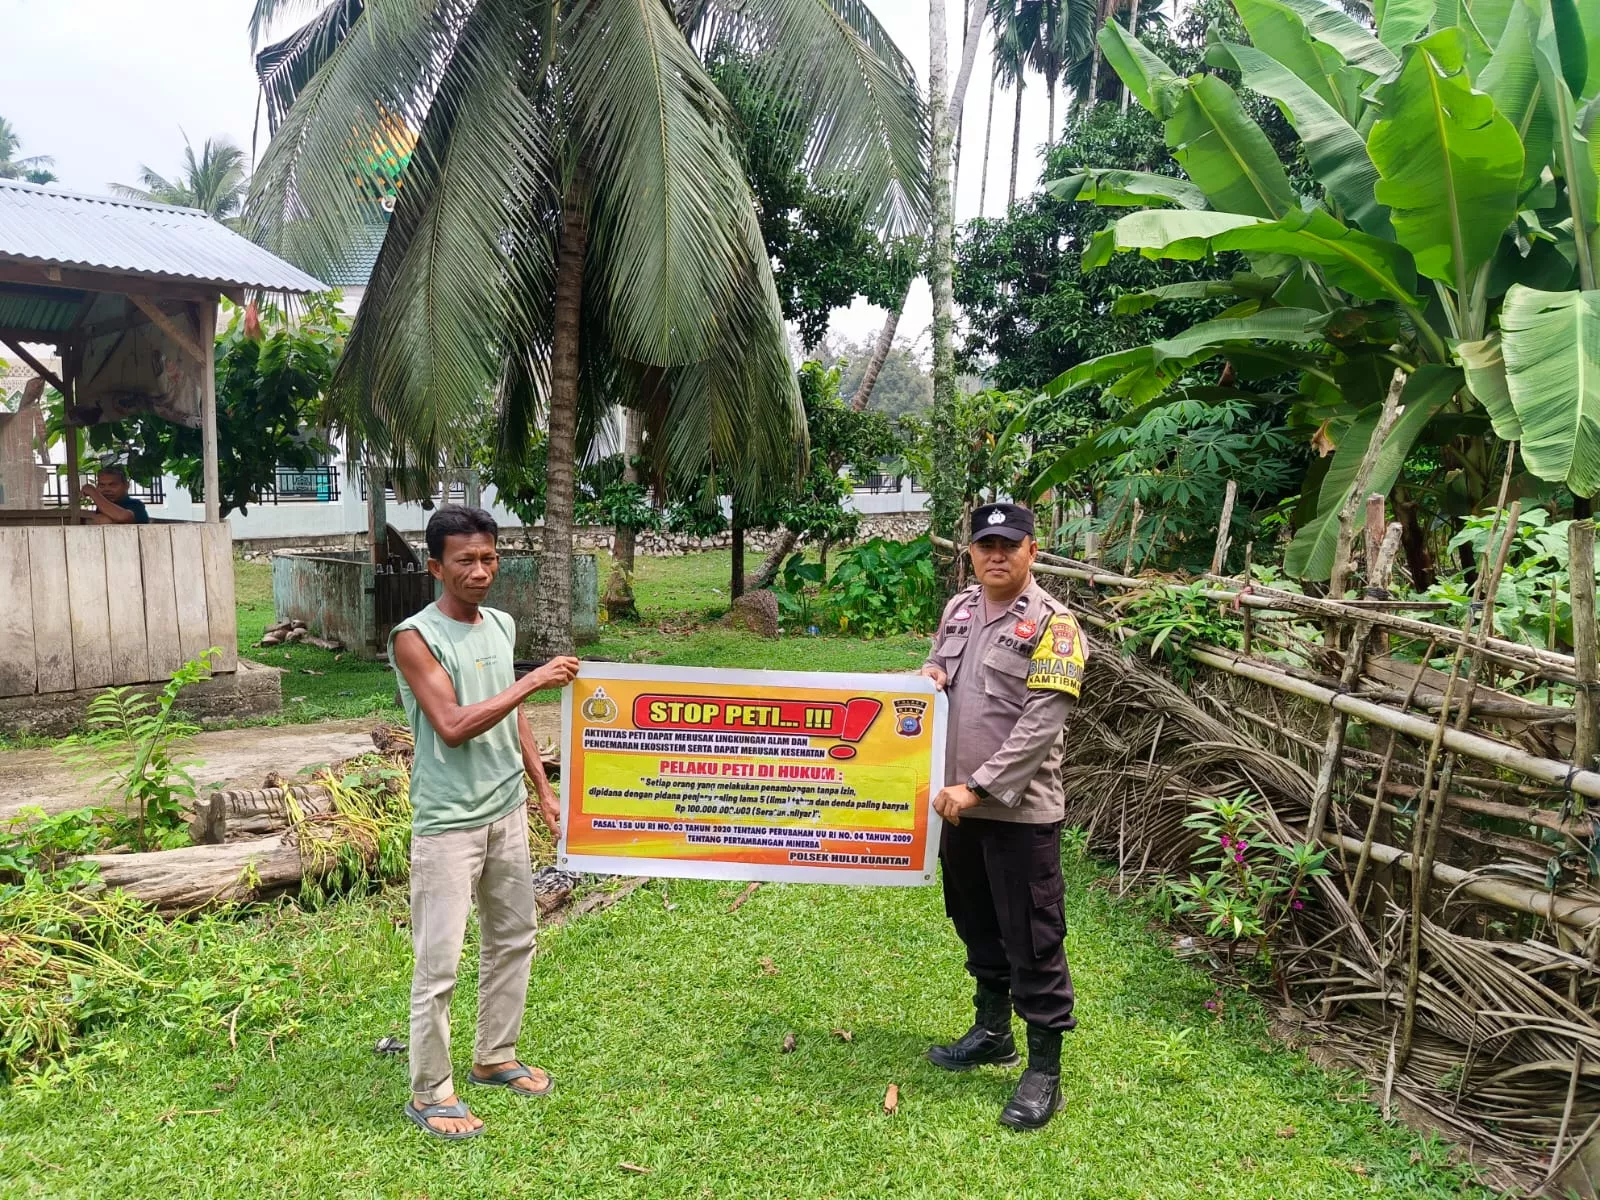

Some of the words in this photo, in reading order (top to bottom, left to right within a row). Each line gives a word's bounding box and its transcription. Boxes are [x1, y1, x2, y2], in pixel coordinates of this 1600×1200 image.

[650, 701, 719, 724] STOP
[725, 704, 799, 727] PETI...
[804, 708, 832, 729] !!!
[584, 729, 627, 739] AKTIVITAS
[628, 730, 646, 740] PETI
[648, 731, 673, 741] DAPAT
[674, 733, 714, 742] MERUSAK
[715, 734, 766, 744] LINGKUNGAN
[768, 737, 790, 745] ALAM
[791, 738, 808, 746] DAN
[584, 740, 639, 750] PENCEMARAN
[640, 742, 686, 752] EKOSISTEM
[688, 744, 712, 753] SERTA
[714, 745, 739, 754] DAPAT
[740, 746, 779, 756] MERUSAK
[781, 748, 825, 758] KESEHATAN
[660, 760, 718, 776] PELAKU
[721, 764, 754, 777] PETI
[758, 765, 774, 778] DI
[778, 766, 835, 780] HUKUM
[646, 778, 671, 789] Setiap
[673, 780, 695, 790] orang
[697, 782, 716, 791] yang
[717, 782, 759, 791] melakukan
[817, 786, 839, 796] tanpa
[588, 787, 622, 797] dipidana
[624, 790, 653, 800] dengan
[654, 792, 681, 801] pidana
[739, 795, 758, 803] lama
[815, 799, 829, 807] dan
[831, 800, 855, 808] denda
[856, 800, 881, 810] paling
[882, 802, 909, 812] banyak
[675, 804, 686, 814] Rp
[593, 820, 616, 828] PASAL
[618, 821, 632, 829] 158
[634, 821, 646, 829] UU
[648, 822, 655, 830] RI
[657, 822, 672, 830] NO.
[673, 823, 683, 831] 03
[685, 824, 710, 832] TAHUN
[712, 825, 731, 833] 2020
[733, 826, 767, 834] TENTANG
[769, 828, 814, 837] PERUBAHAN
[815, 830, 827, 838] UU
[854, 832, 864, 840] 04
[866, 832, 890, 842] TAHUN
[892, 834, 911, 842] 2009
[687, 834, 721, 843] TENTANG
[724, 836, 784, 847] PERTAMBANGAN
[785, 839, 819, 848] MINERBA
[790, 852, 830, 862] POLSEK
[831, 854, 858, 863] HULU
[861, 855, 909, 865] KUANTAN
